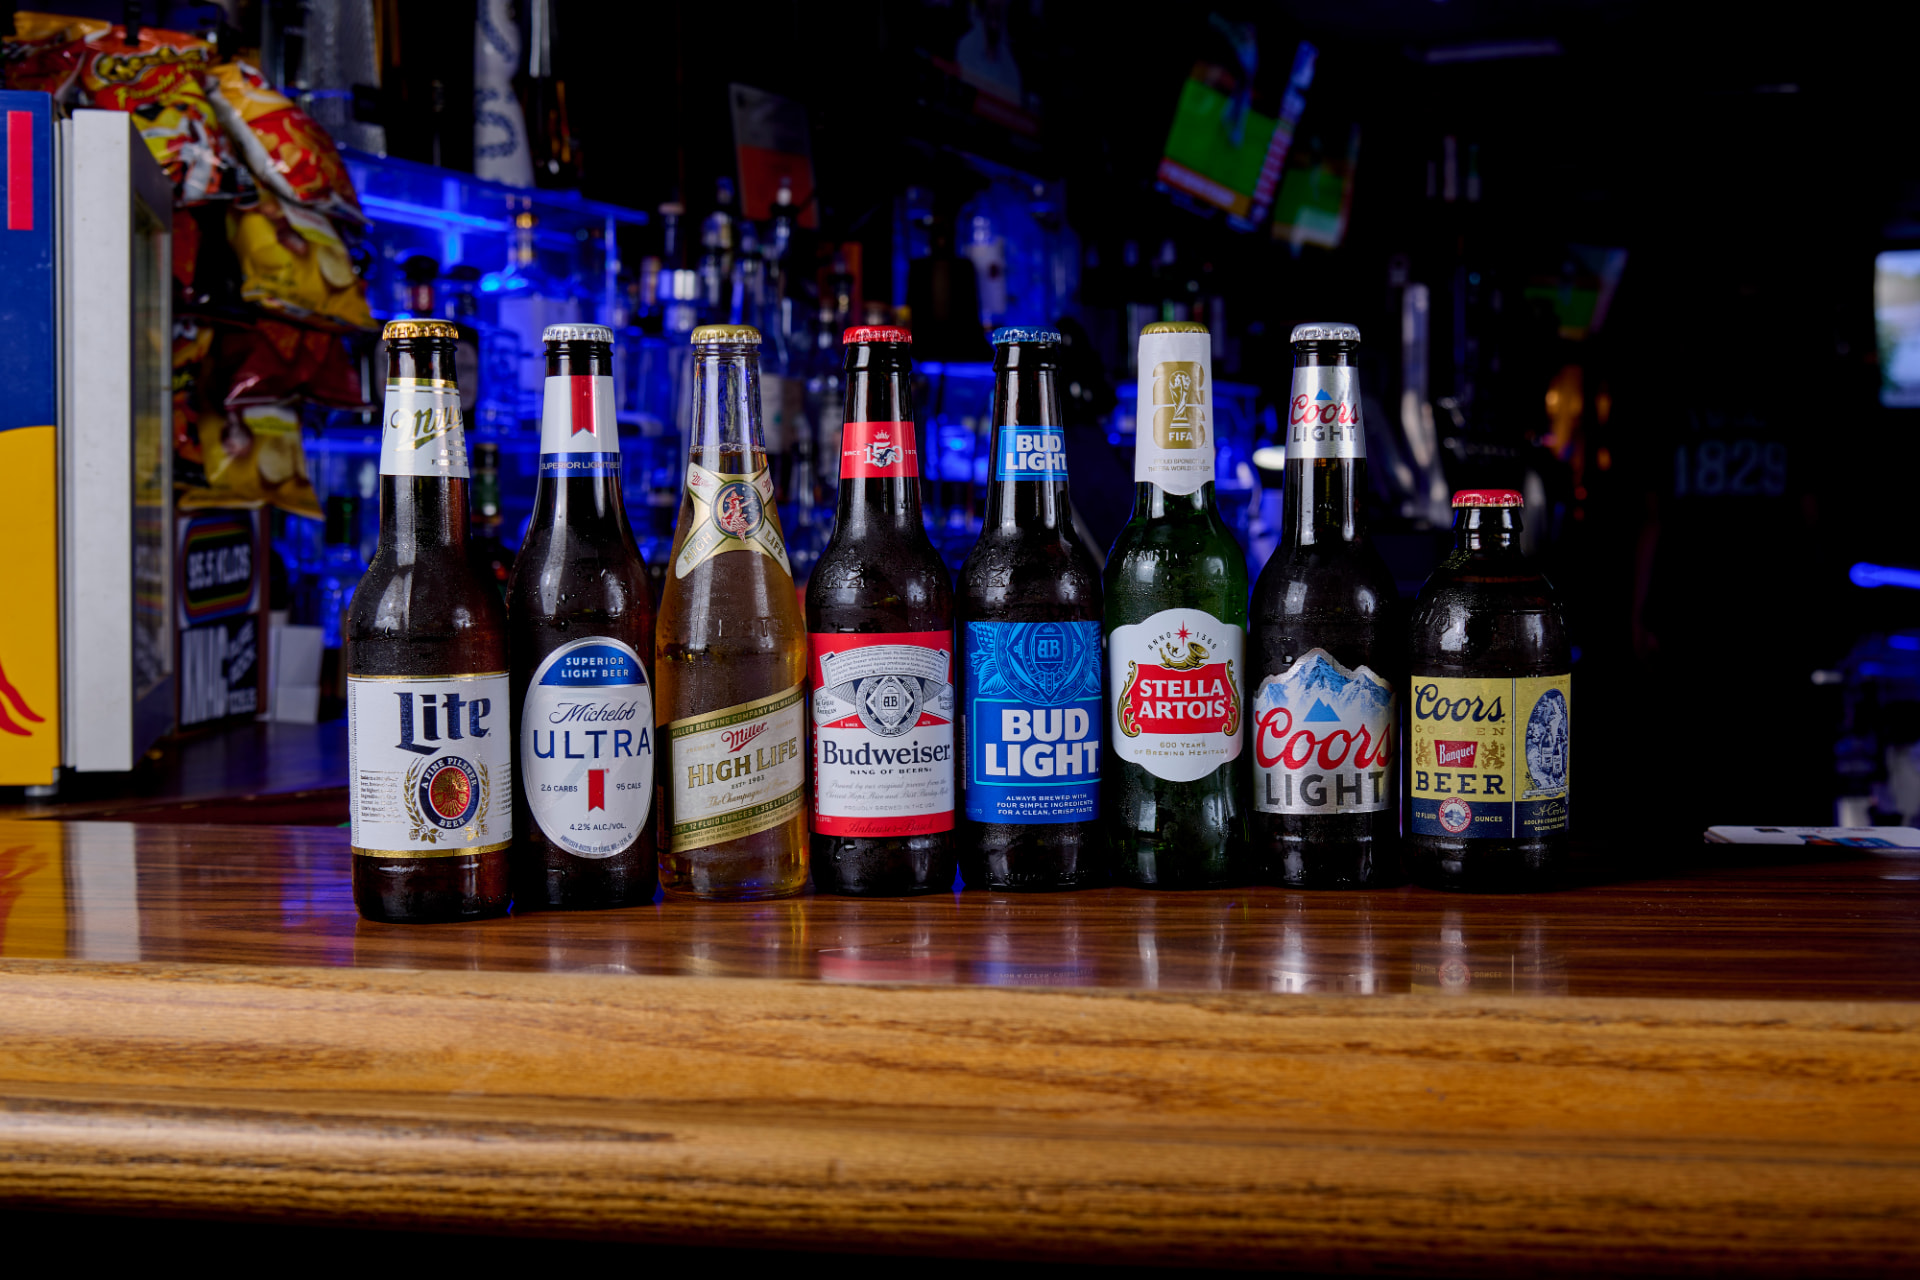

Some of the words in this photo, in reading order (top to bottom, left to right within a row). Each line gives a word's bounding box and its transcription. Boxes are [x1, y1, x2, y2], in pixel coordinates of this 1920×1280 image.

[1291, 394, 1359, 424] Coors
[1015, 434, 1062, 453] BUD
[1168, 431, 1193, 441] FIFA
[1293, 425, 1356, 443] LIGHT
[1005, 452, 1067, 471] LIGHT
[683, 531, 713, 565] HIGH
[764, 530, 784, 559] LIFE
[1147, 631, 1172, 651] ANNO
[566, 656, 625, 666] SUPERIOR
[561, 669, 598, 678] LIGHT
[602, 669, 629, 677] BEER
[1139, 679, 1225, 698] STELLA
[549, 701, 638, 724] Michelob
[1138, 701, 1225, 720] ARTOIS
[1414, 683, 1506, 722] Coors
[393, 692, 491, 756] Lite
[672, 725, 694, 737] MILLER
[696, 718, 731, 732] BREWING
[732, 707, 768, 723] COMPANY
[1002, 708, 1090, 742] BUD
[1415, 725, 1506, 736] GOEN
[533, 727, 652, 759] ULTRA
[721, 722, 767, 754] Miller
[1255, 707, 1393, 770] Coors
[688, 754, 752, 789] HIGH
[756, 737, 798, 772] LIFE
[822, 740, 951, 766] Budweiser
[985, 740, 1099, 777] LIGHT
[1439, 744, 1475, 764] Banquet
[424, 759, 446, 780] FINE
[447, 757, 478, 787] PILSNER
[420, 782, 430, 790] A
[540, 784, 552, 792] 2.6
[616, 783, 626, 791] 95
[627, 782, 642, 790] CALS
[748, 775, 765, 785] 1903
[1265, 771, 1385, 807] LIGHT
[1415, 770, 1506, 795] BEER
[1050, 800, 1094, 808] INGREDIENTS
[1076, 806, 1093, 814] TASTE
[439, 818, 467, 828] BEER
[690, 823, 697, 831] 12
[698, 816, 721, 829] FLUID
[722, 808, 754, 824] OUNCES
[845, 818, 934, 833] Anheuser-Busch
[1421, 812, 1437, 820] FLUID
[569, 823, 591, 831] 4.2%
